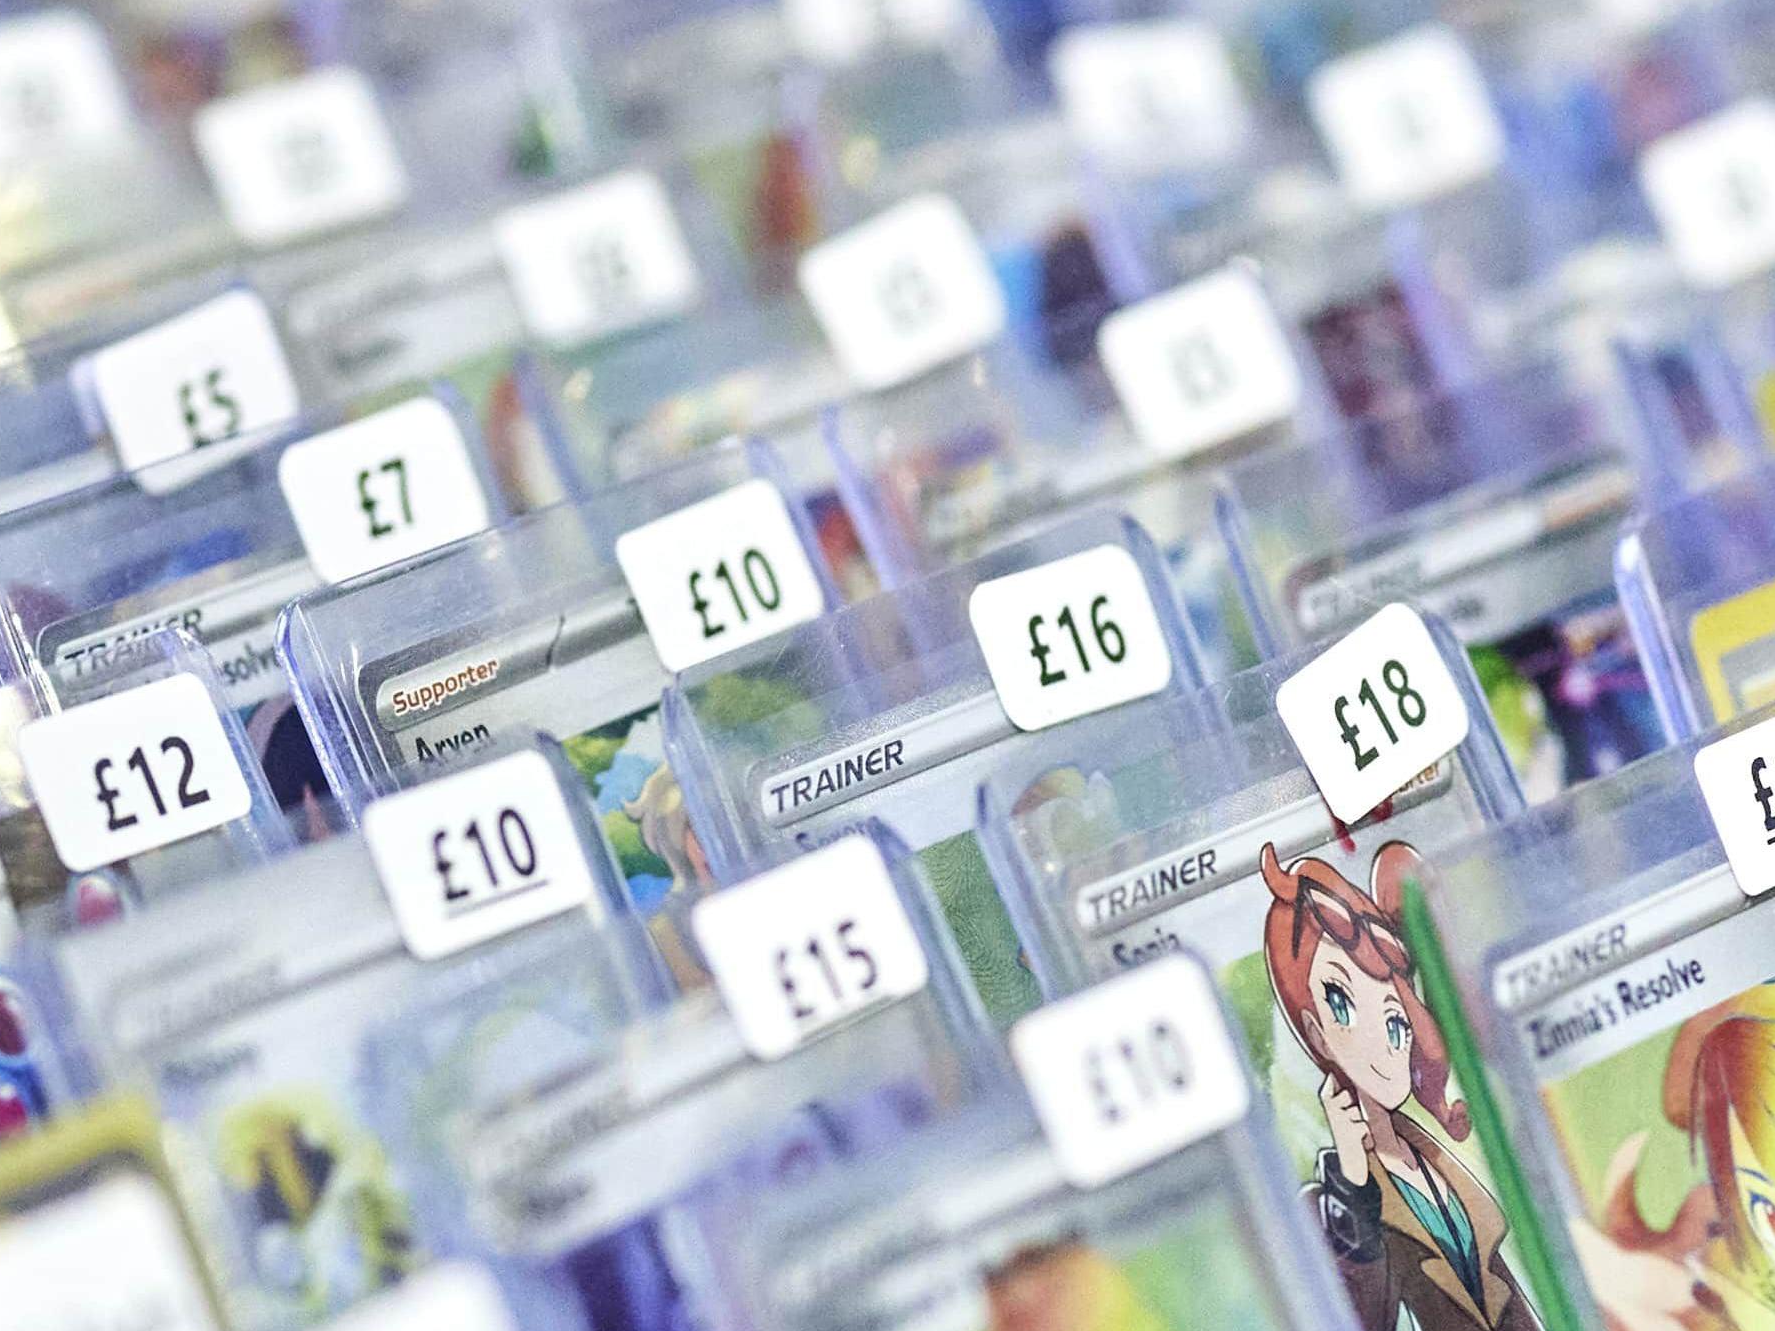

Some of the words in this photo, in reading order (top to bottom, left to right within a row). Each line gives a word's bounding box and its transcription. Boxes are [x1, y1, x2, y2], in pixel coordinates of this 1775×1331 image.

[179, 366, 244, 449] £5
[355, 459, 415, 538] £7
[687, 547, 784, 641] £10
[1029, 594, 1128, 688] £16
[390, 656, 500, 715] Supporter
[1333, 658, 1428, 772] £18
[92, 734, 212, 833] £12
[770, 739, 905, 814] TRAINER
[429, 806, 539, 902] £10
[1086, 848, 1219, 921] TRAINER
[773, 920, 878, 1019] £15
[1617, 957, 1707, 1017] Resolve
